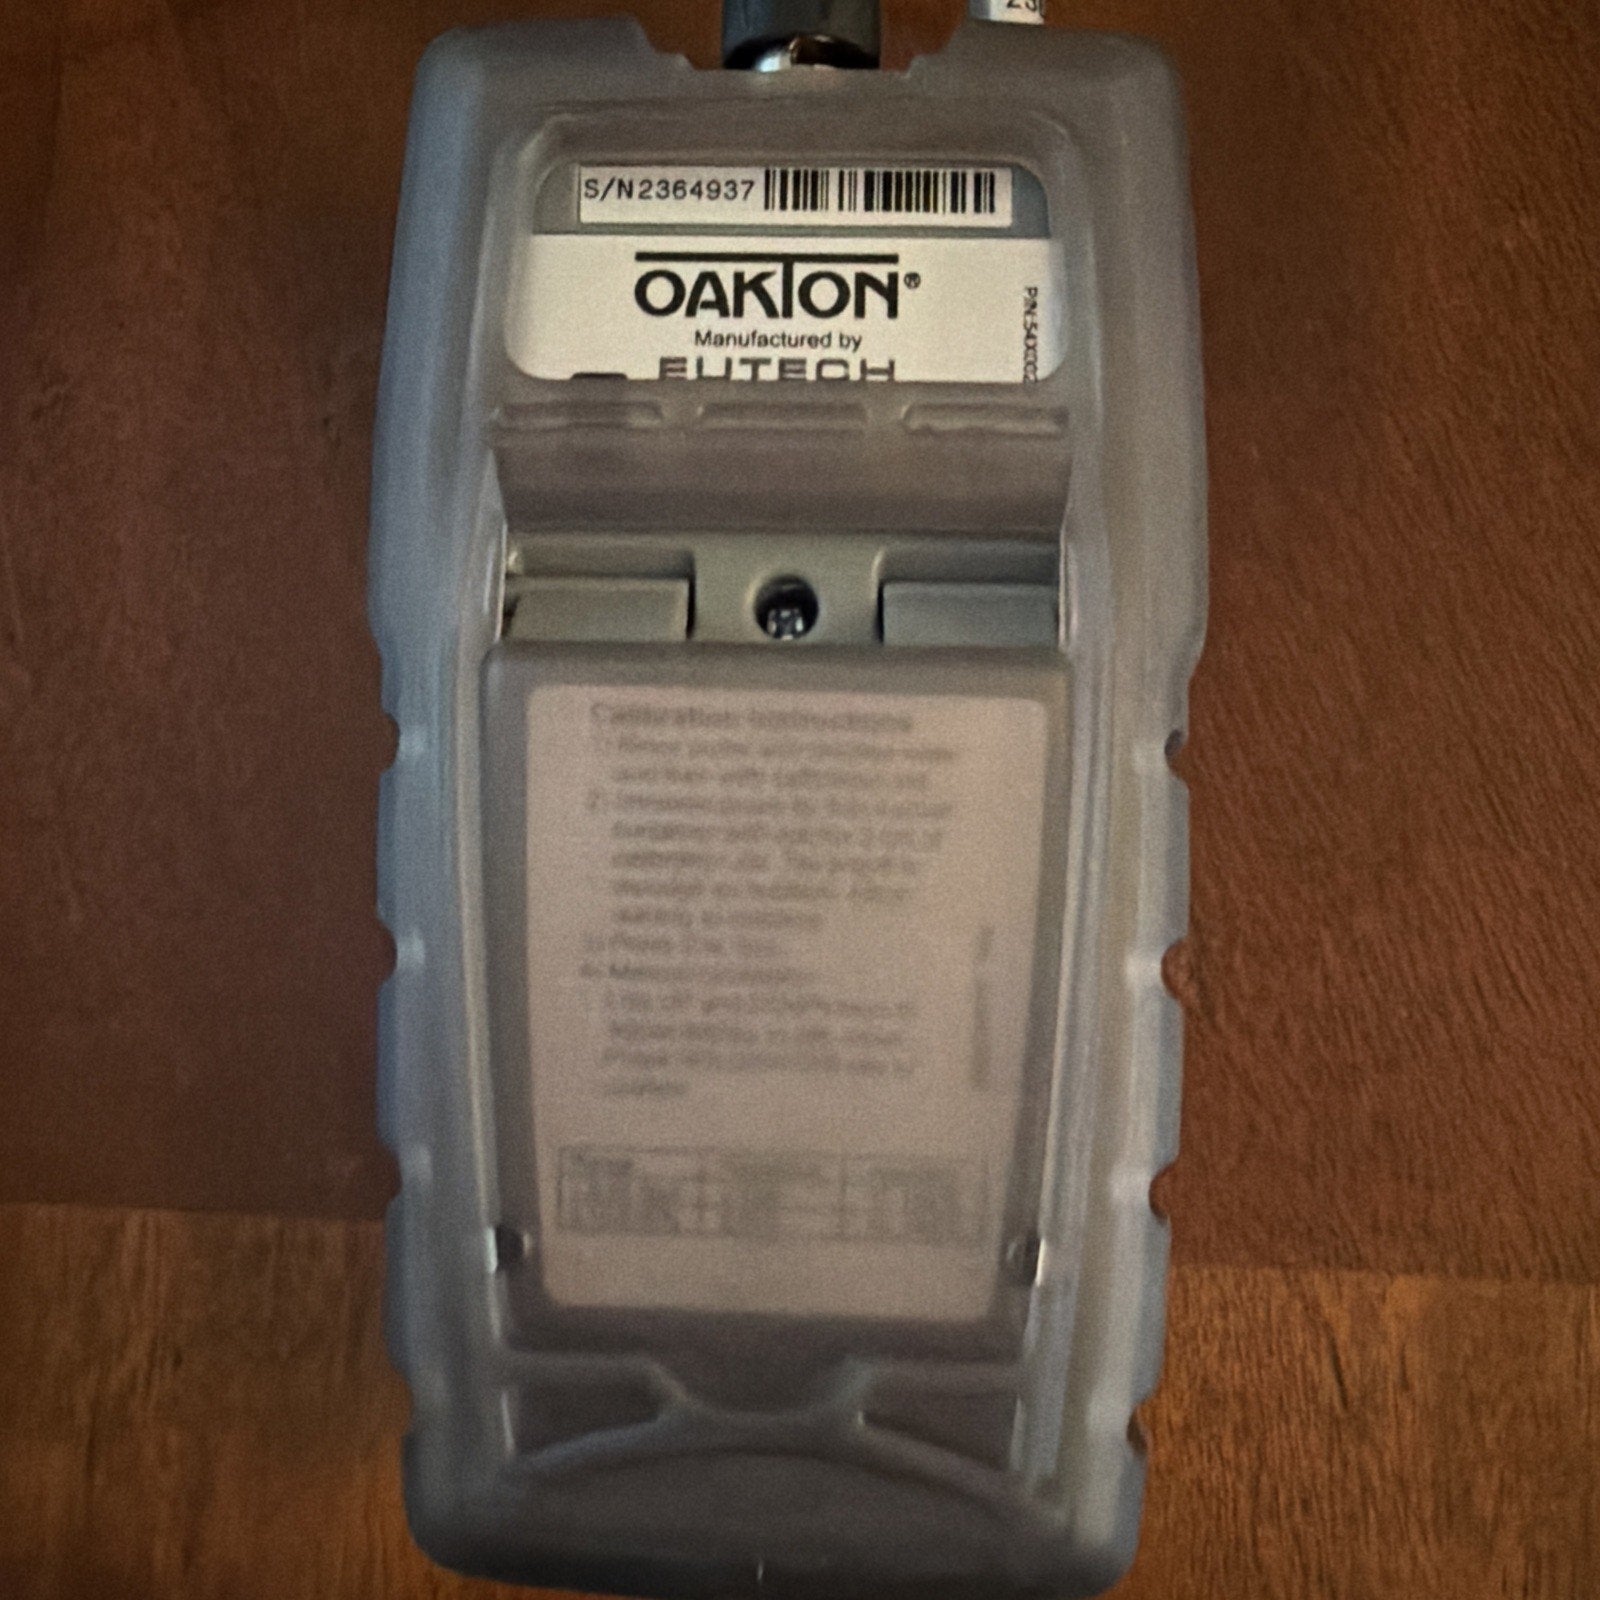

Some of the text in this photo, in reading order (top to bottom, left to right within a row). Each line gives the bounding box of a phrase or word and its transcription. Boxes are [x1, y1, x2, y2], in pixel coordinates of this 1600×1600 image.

[694, 329, 862, 352] Manufactured by
[659, 356, 895, 381] EUTECH
